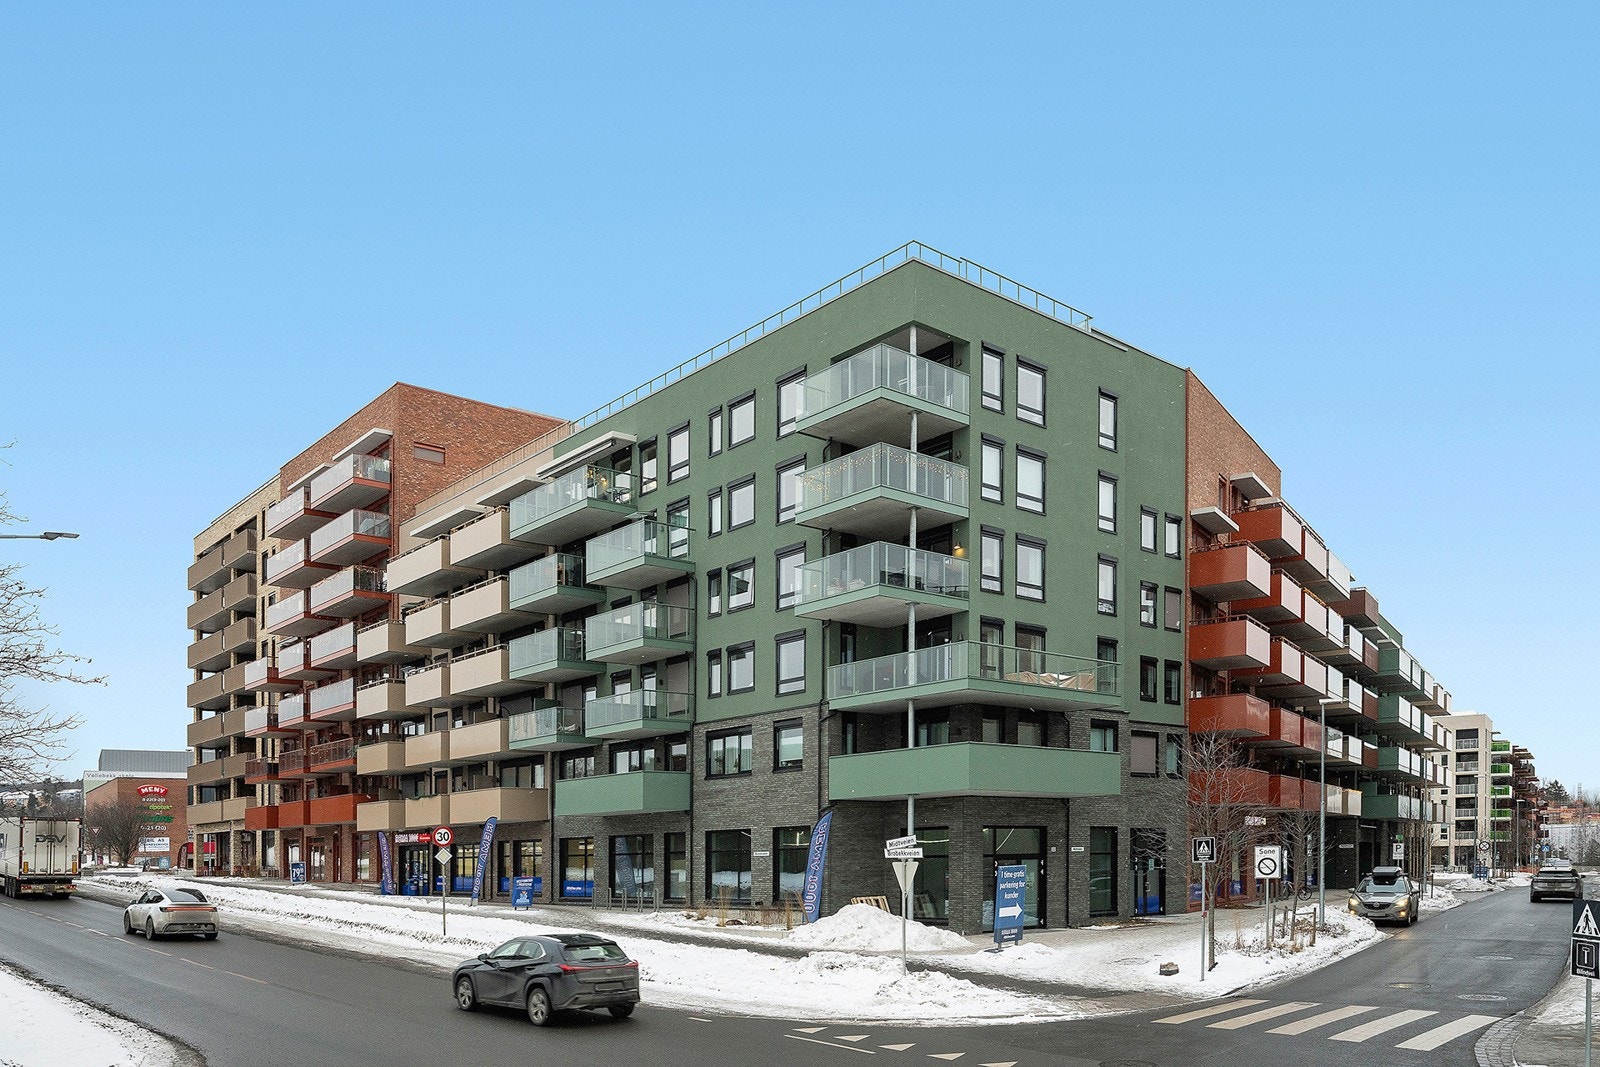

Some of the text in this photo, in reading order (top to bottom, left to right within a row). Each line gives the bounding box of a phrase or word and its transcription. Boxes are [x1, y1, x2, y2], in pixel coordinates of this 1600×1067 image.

[140, 786, 166, 794] MENY
[36, 834, 67, 844] DSV
[436, 831, 449, 842] 30
[888, 838, 915, 848] Midtveien
[1395, 844, 1402, 852] P
[999, 881, 1019, 890] parkering
[1004, 891, 1019, 899] kunder
[1576, 968, 1596, 977] Blindvei
